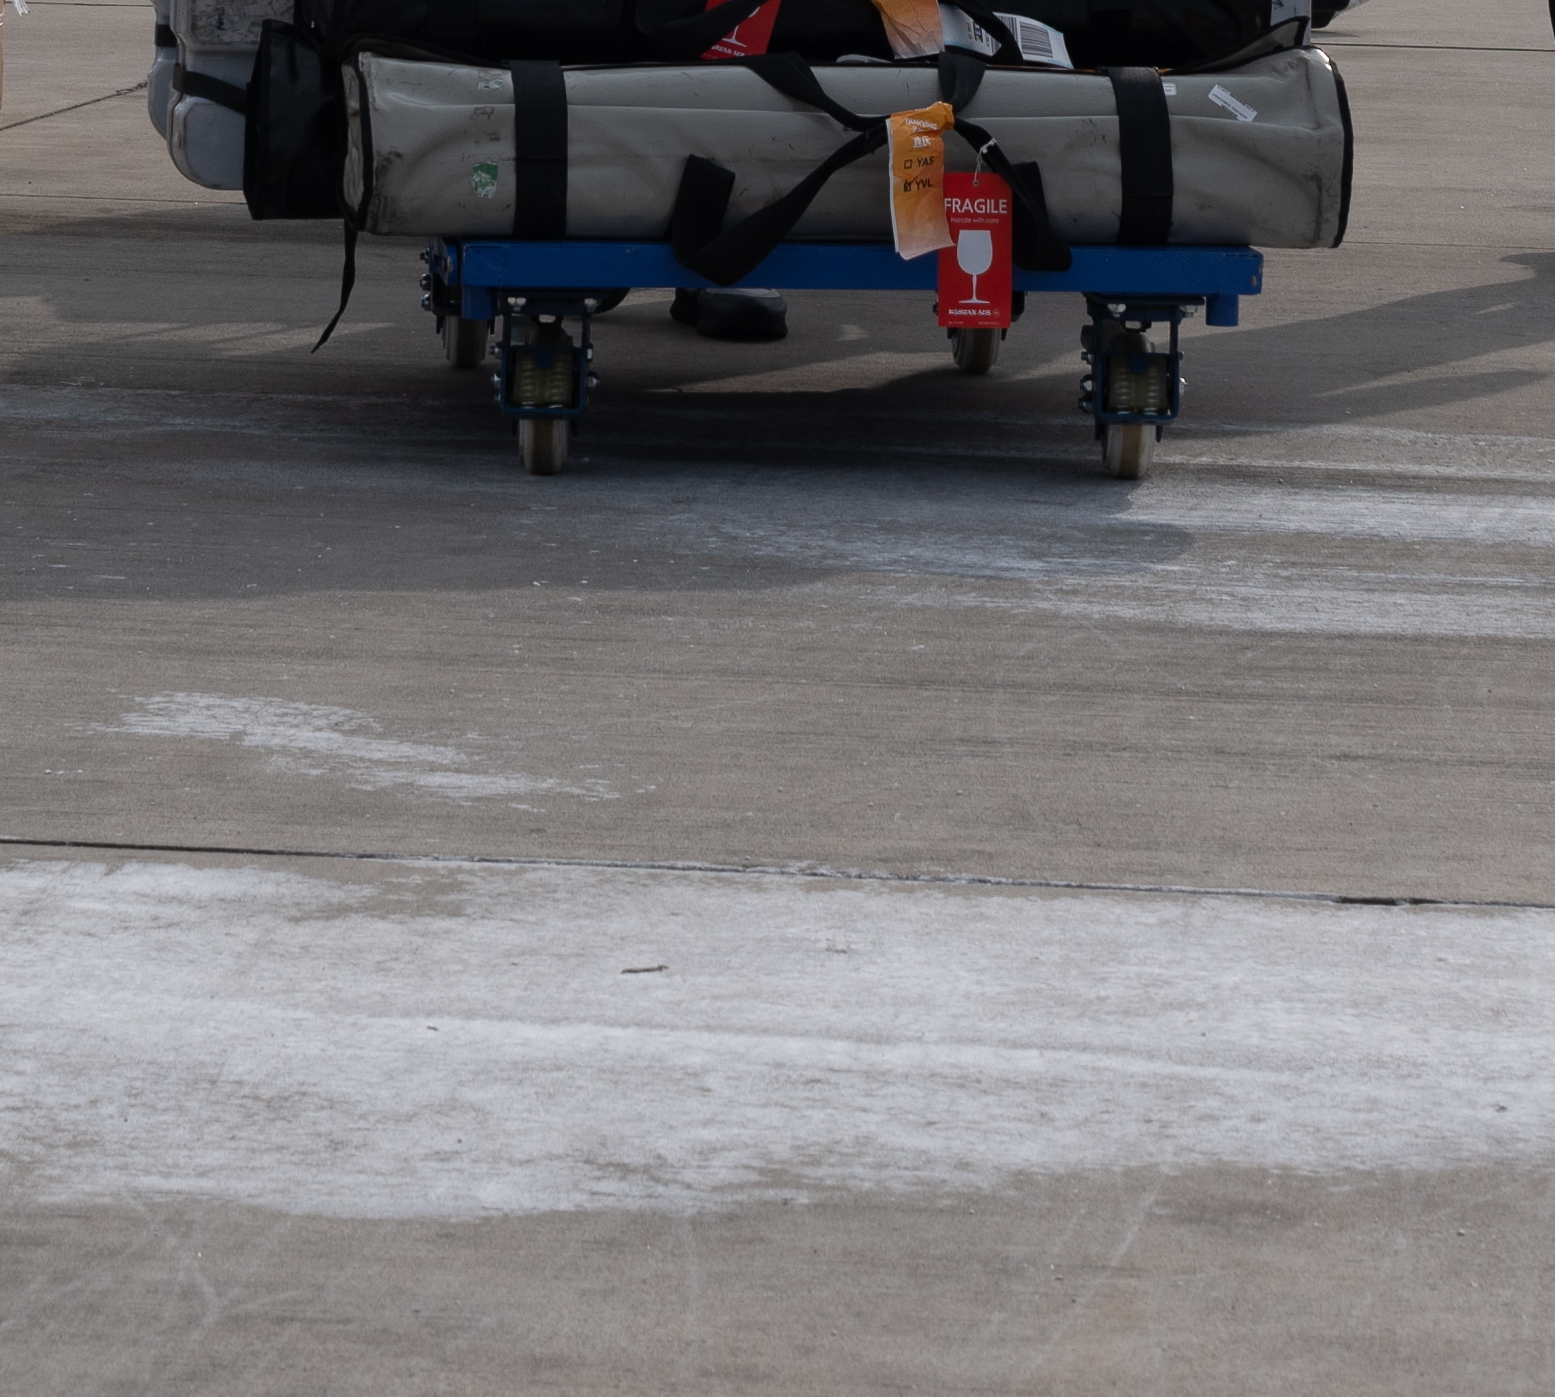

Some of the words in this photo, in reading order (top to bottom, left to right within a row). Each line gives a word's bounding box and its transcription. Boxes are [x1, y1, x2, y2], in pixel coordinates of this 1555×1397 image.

[916, 156, 935, 168] YAS
[915, 178, 933, 191] YVL
[944, 197, 1008, 214] FRAGILE
